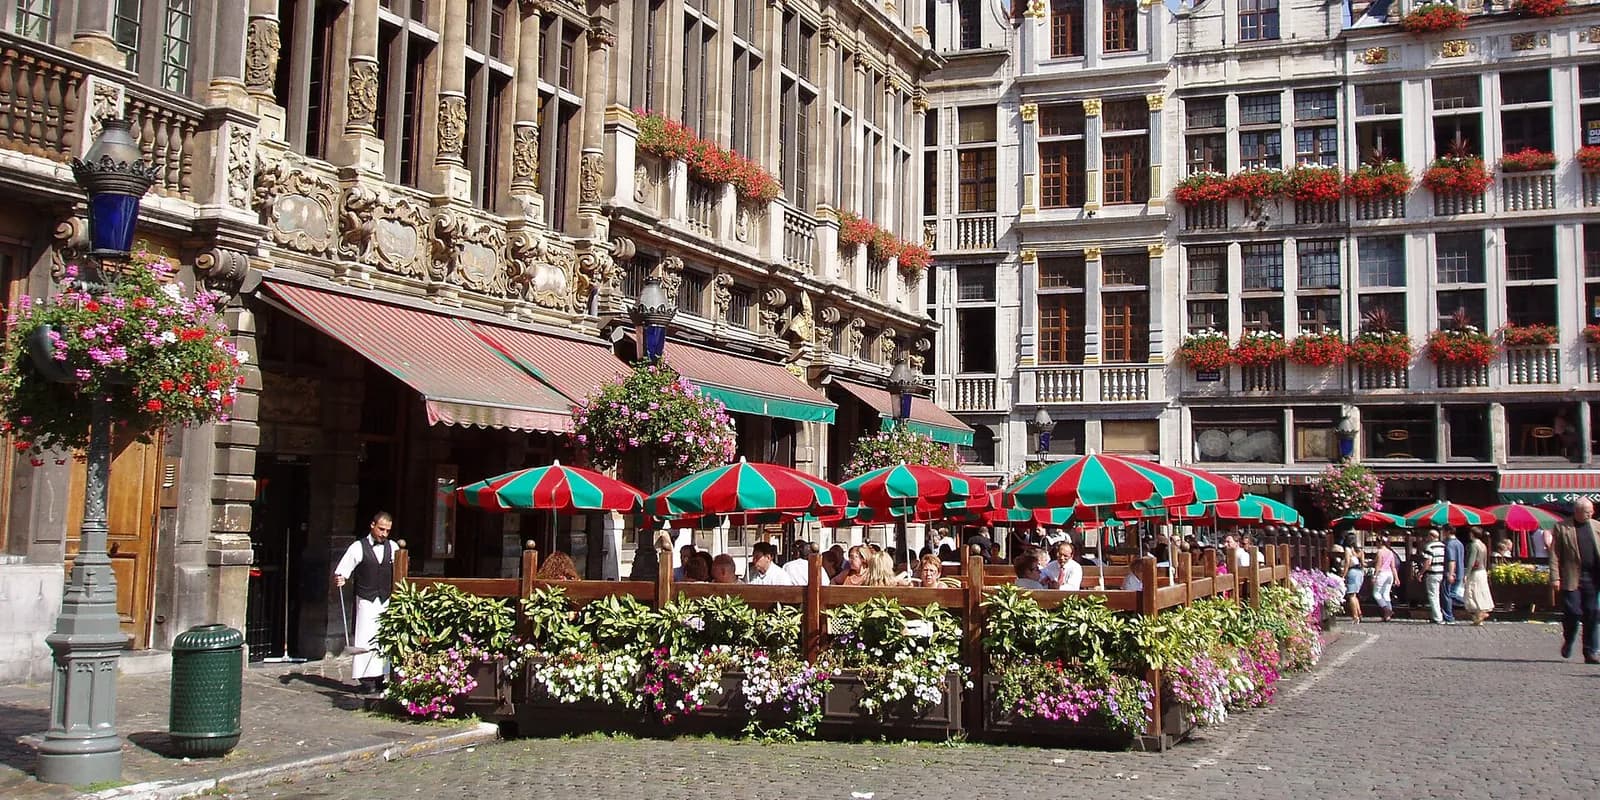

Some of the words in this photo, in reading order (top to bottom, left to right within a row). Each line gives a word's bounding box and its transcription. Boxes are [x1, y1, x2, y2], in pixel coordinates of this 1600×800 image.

[1231, 474, 1267, 485] Belgian
[1272, 474, 1290, 485] Art
[1543, 493, 1558, 503] EL
[1563, 493, 1600, 503] GRCO
